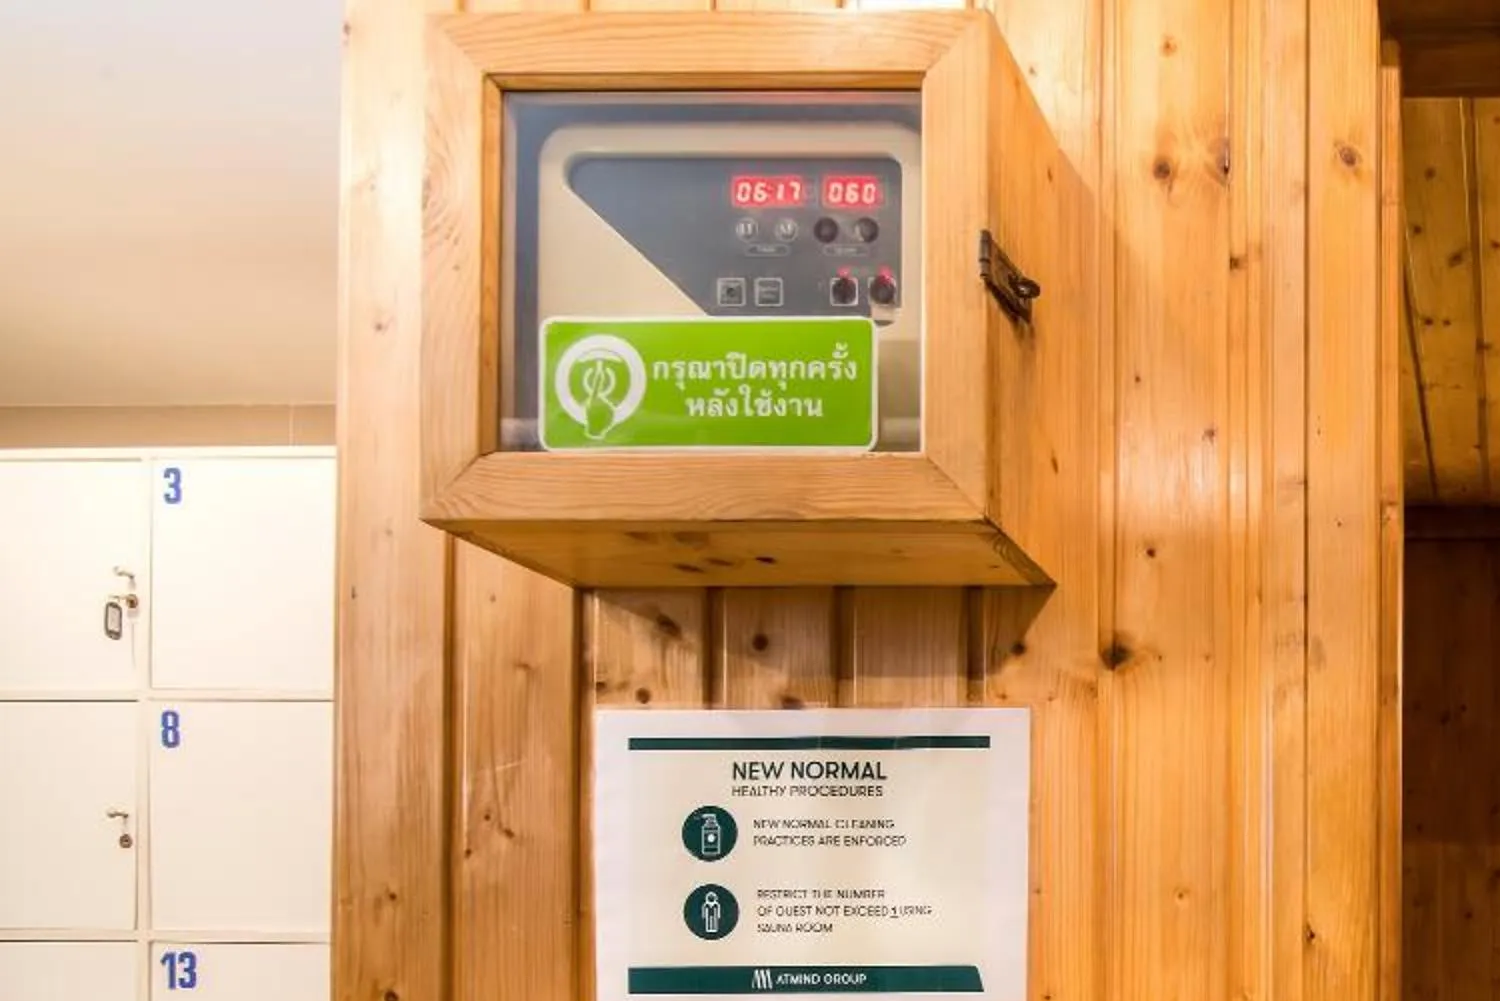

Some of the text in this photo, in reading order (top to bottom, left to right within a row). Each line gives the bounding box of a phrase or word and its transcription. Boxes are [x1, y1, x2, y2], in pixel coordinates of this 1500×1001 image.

[827, 182, 877, 205] 060
[653, 342, 858, 391] กรุณาปิดทุกครั้ง
[685, 384, 823, 417] หลังใช้งาน
[162, 467, 183, 505] 3
[160, 710, 182, 749] 8
[732, 761, 888, 780] NEW NORMAL
[731, 785, 884, 797] HEALTHY PROCEDURES
[753, 836, 907, 847] PRACTICES ARE ENFORCED
[756, 905, 772, 917] OF
[815, 905, 841, 917] NOT
[843, 905, 889, 917] EXCEED
[160, 951, 198, 990] 13
[775, 973, 868, 985] ATMIND GROUP
